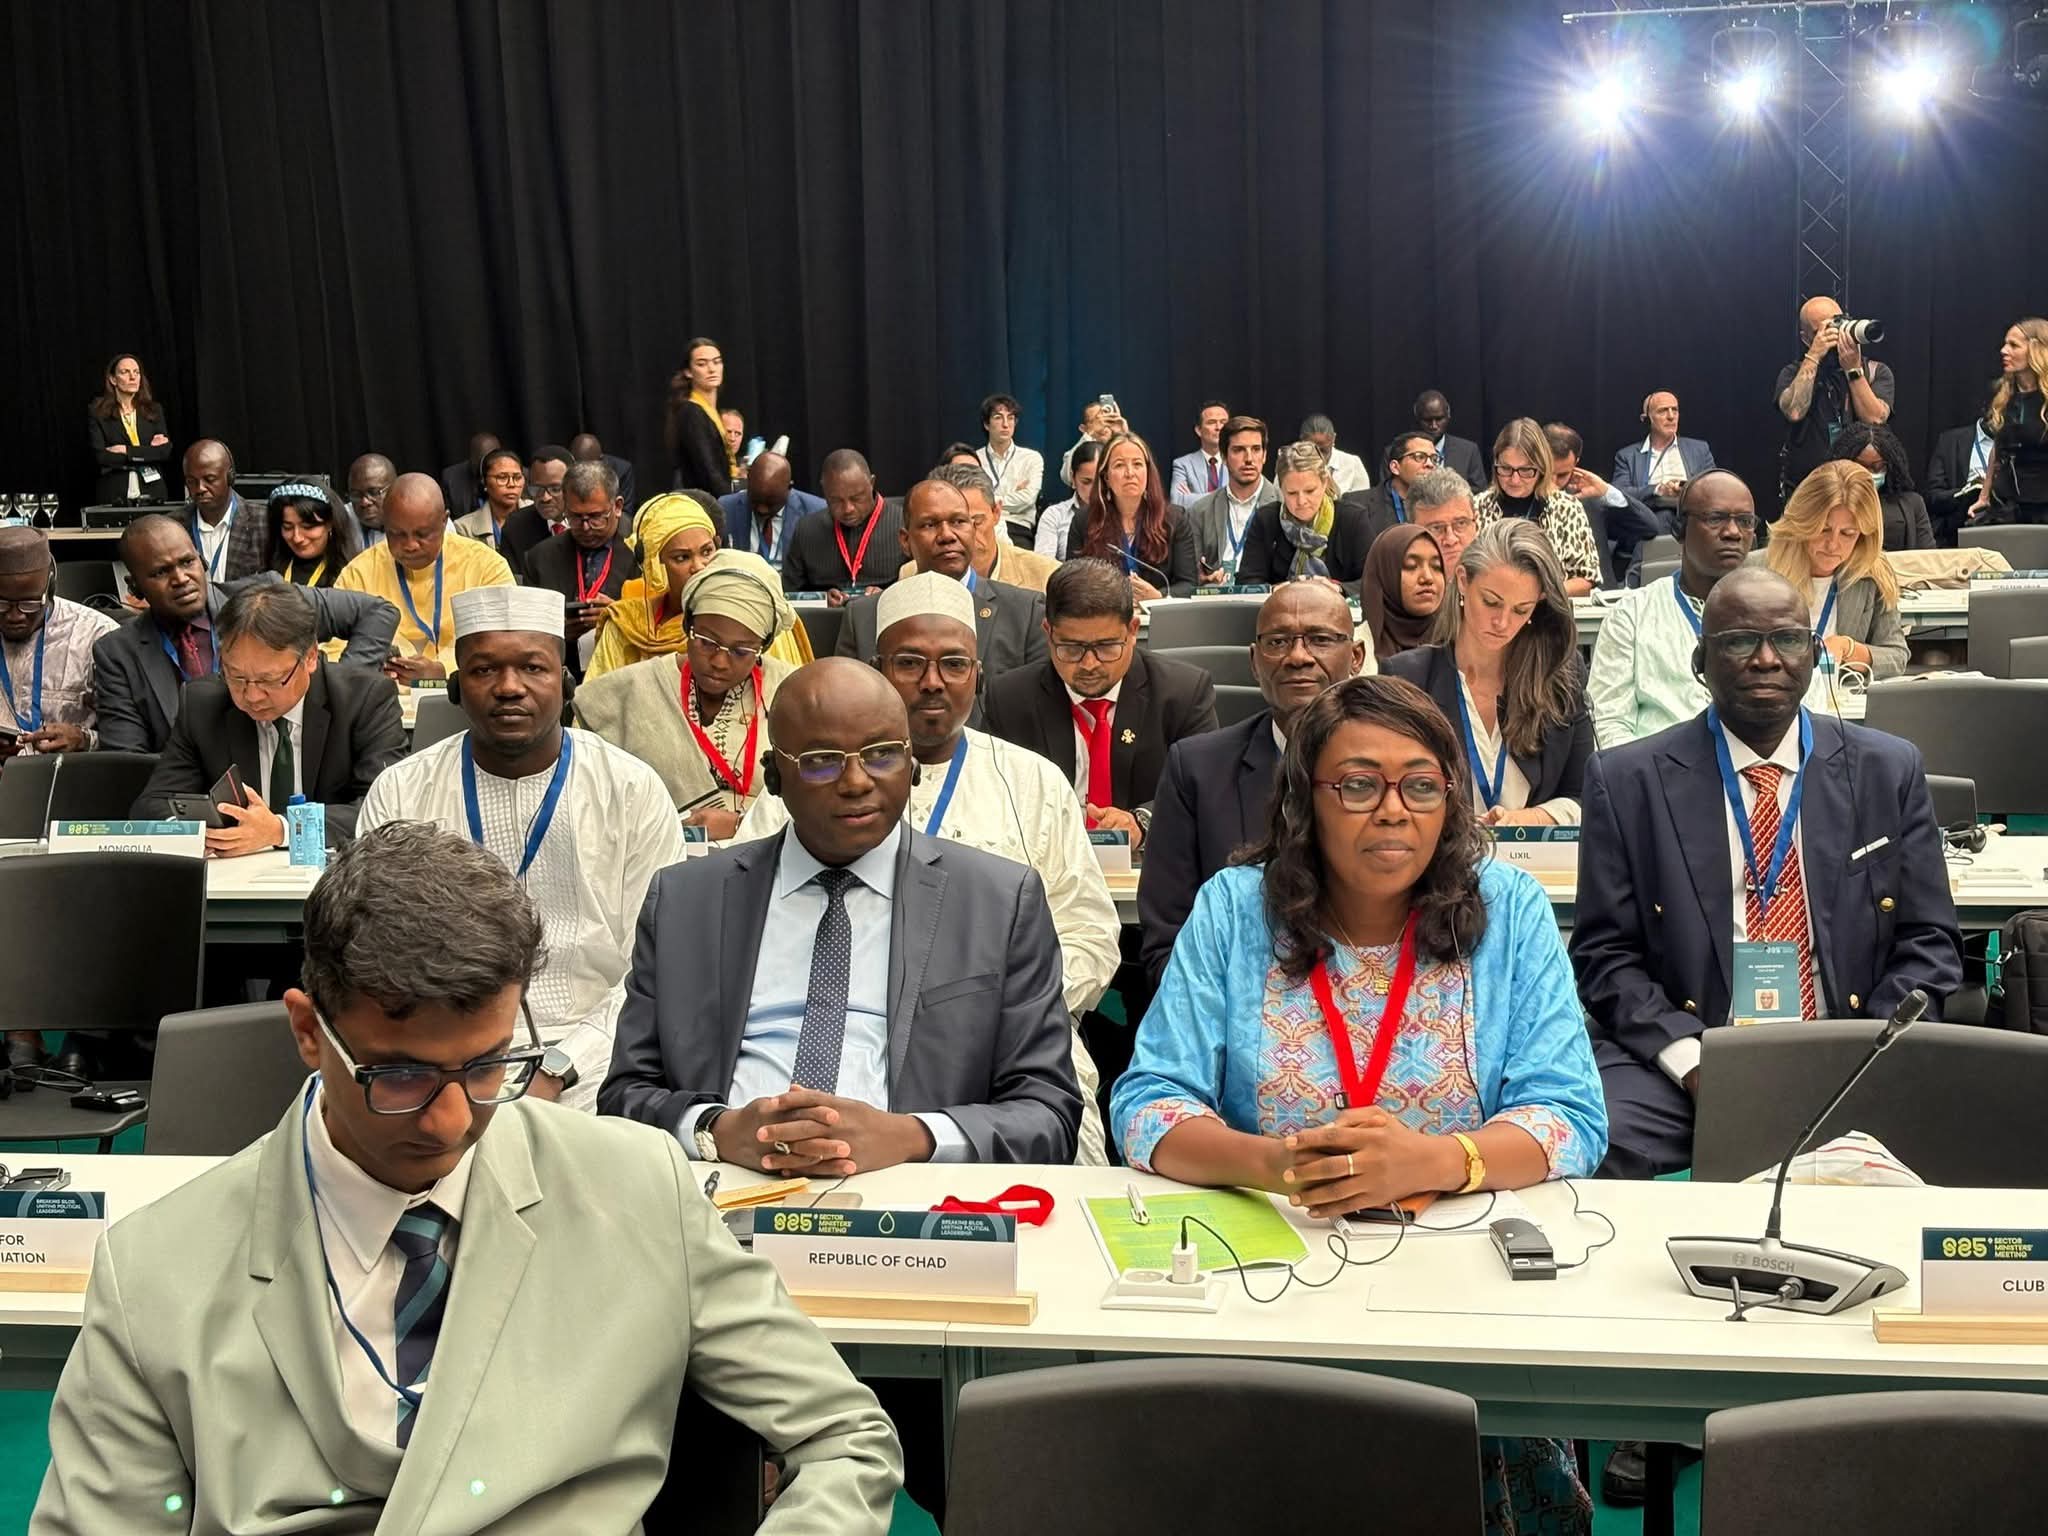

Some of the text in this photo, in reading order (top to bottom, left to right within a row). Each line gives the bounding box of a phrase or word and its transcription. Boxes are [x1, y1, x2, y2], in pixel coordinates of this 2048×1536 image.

[0, 1234, 25, 1246] FOR
[1, 1252, 46, 1264] IATION
[809, 1252, 947, 1269] REPUBLIC OF CHAD
[1752, 1256, 1795, 1272] BOSCH
[2002, 1280, 2045, 1292] CLUB
